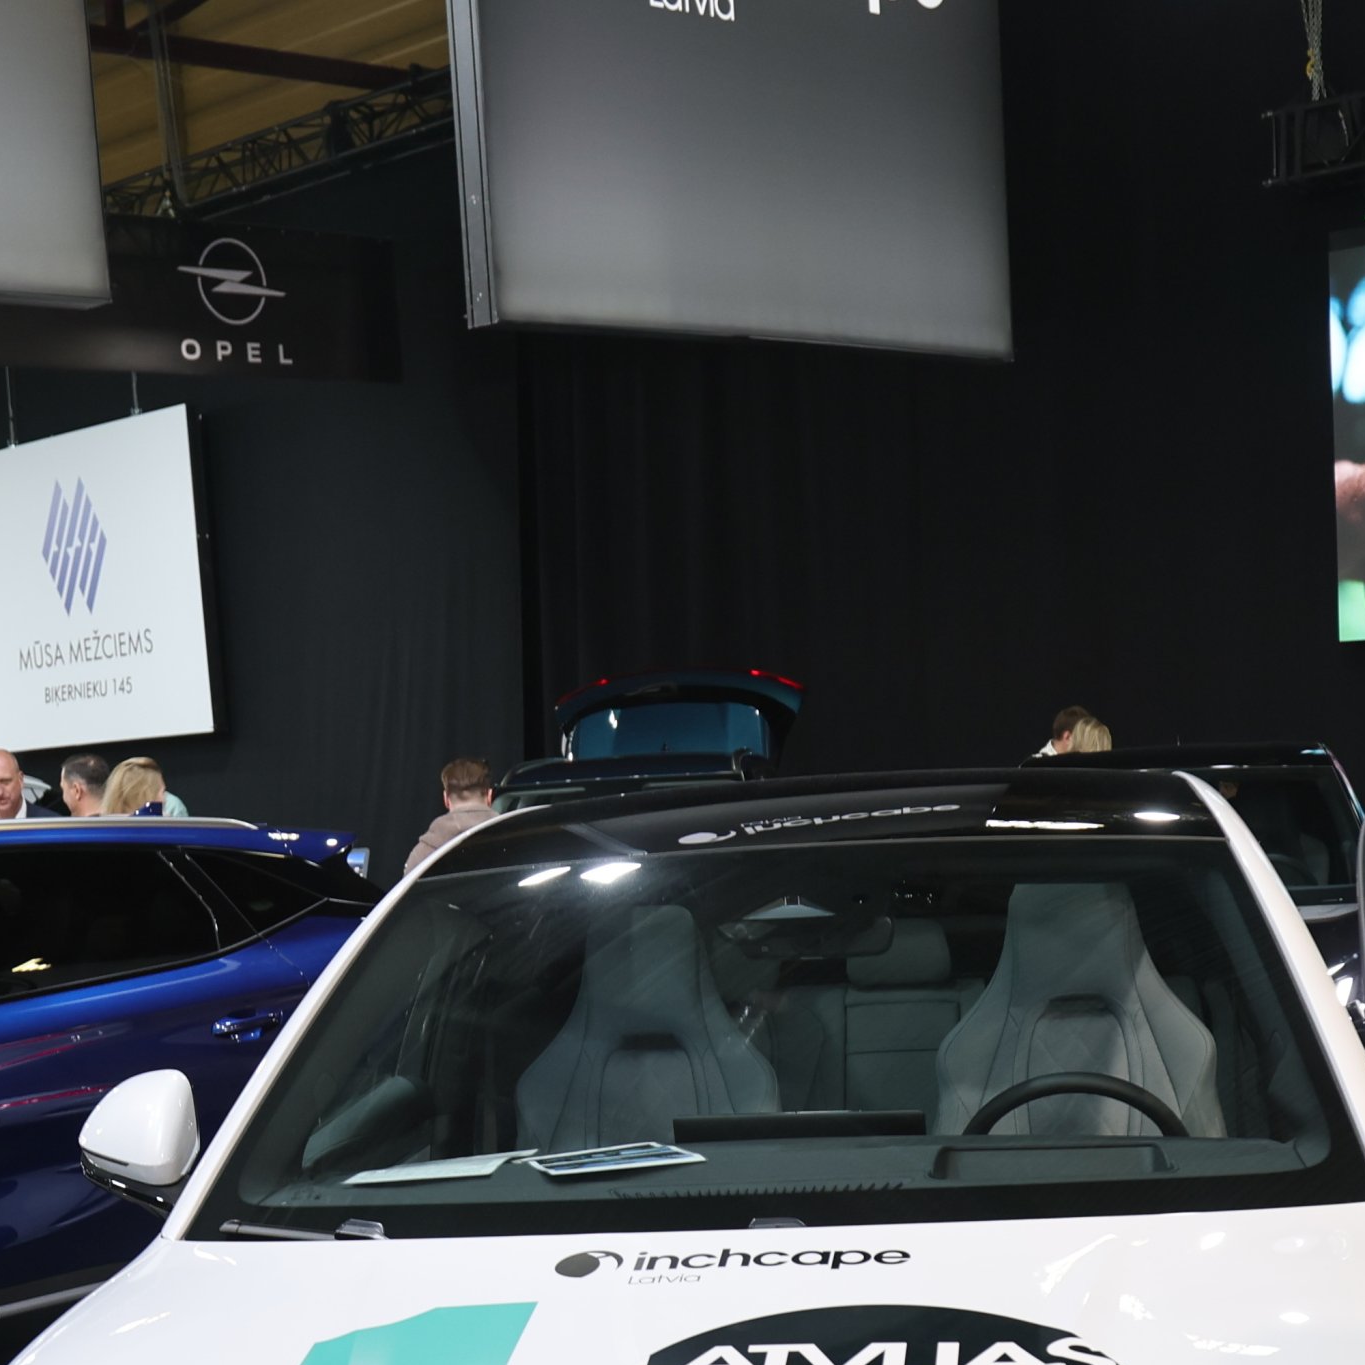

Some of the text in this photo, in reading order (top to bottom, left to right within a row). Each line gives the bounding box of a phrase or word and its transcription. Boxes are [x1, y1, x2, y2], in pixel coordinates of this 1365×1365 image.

[181, 338, 294, 365] OPEL
[19, 628, 154, 671] MŪSA MEŽCIEMS
[44, 676, 133, 706] BIĶERNIEKU 145
[633, 1248, 911, 1270] inchcape
[628, 1272, 702, 1285] Latvia
